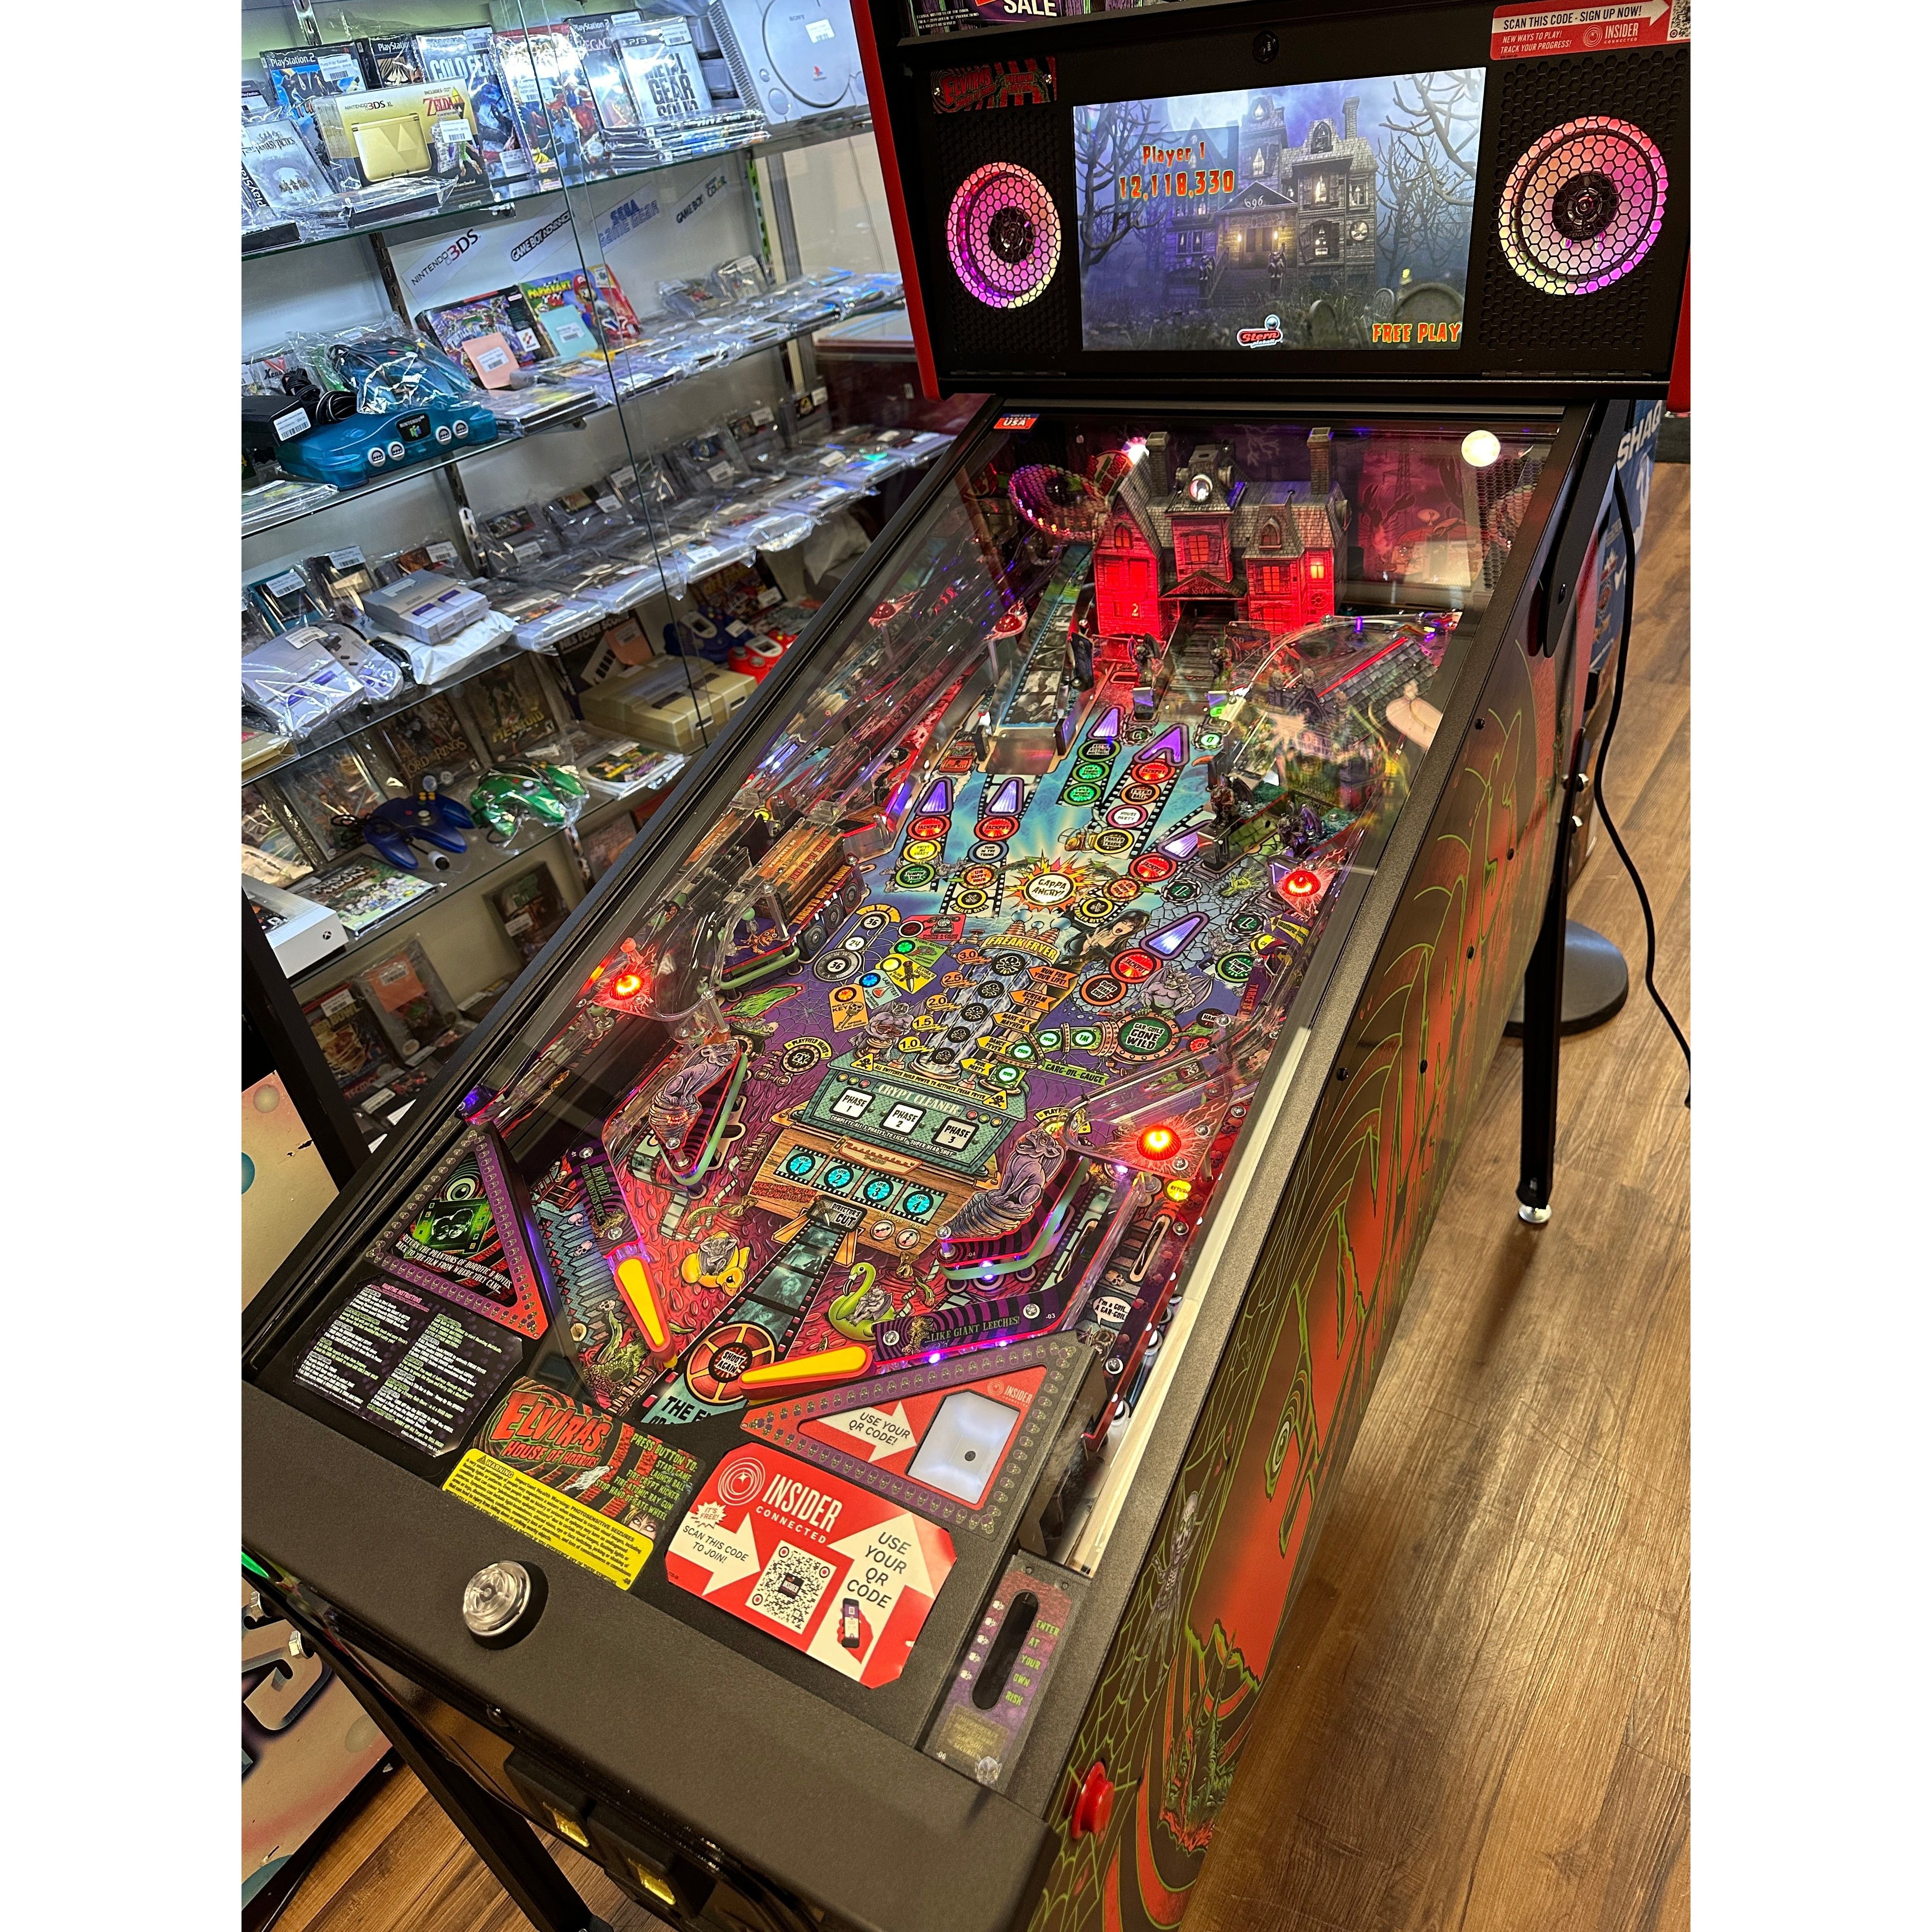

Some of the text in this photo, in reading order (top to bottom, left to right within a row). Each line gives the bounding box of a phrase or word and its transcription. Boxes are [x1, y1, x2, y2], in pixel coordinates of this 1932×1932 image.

[1004, 0, 1057, 17] SALE
[1504, 18, 1527, 30] SCAN
[1529, 16, 1548, 26] THIS
[1551, 13, 1573, 25] CODE
[1580, 11, 1601, 22] SIGN
[1603, 10, 1615, 19] UP
[1617, 6, 1642, 17] NOW!
[1503, 30, 1563, 44] NEW WAYS TO PLAY!
[1605, 23, 1639, 39] INSIDER
[1500, 40, 1572, 54] TRACK YOUR PROGRESS!
[1006, 72, 1033, 83] PREMIUM
[648, 74, 695, 105] GEAR
[1008, 82, 1031, 94] EDITION
[423, 97, 455, 116] ZELDA
[1142, 141, 1206, 167] Player 1
[1118, 169, 1234, 202] 12,118,330
[1243, 196, 1264, 209] 696
[610, 199, 640, 226] SEGA
[411, 228, 479, 286] NINTENDO 3DS
[1241, 330, 1281, 344] Stern
[1372, 322, 1460, 343] FREE PLAY
[1002, 419, 1027, 428] USA
[1032, 886, 1065, 897] ANGRY!
[1038, 879, 1067, 889] GAPPA
[987, 936, 1057, 960] FREAK FRYER
[1034, 972, 1051, 981] YOUR
[928, 997, 946, 1005] 2.0
[1022, 992, 1047, 1002] SCREAM
[1024, 998, 1040, 1006] TEST
[1000, 1019, 1025, 1029] MAYHEM
[1002, 1012, 1031, 1024] MAKE-OUT
[900, 1038, 918, 1048] 1.0
[988, 1037, 1006, 1046] DANCE
[1127, 1036, 1156, 1050] WILD
[1129, 1029, 1161, 1043] GONE
[984, 1043, 1002, 1051] FEVER
[968, 1064, 986, 1072] PARTY
[974, 1059, 987, 1067] POOL
[1045, 1063, 1106, 1083] GARG-OIL-GAUGE
[843, 1095, 868, 1107] PHASE
[878, 1084, 959, 1115] CRYPT CLEANER
[892, 1110, 918, 1122] PHASE
[944, 1125, 971, 1138] PHASE
[835, 1175, 843, 1184] 2
[872, 1187, 881, 1197] 3
[831, 1202, 862, 1217] DIRECTOR'S
[912, 1202, 921, 1211] 4
[836, 1213, 857, 1227] CUT
[403, 1234, 420, 1249] RETURN
[420, 1245, 431, 1255] THE
[430, 1249, 458, 1264] PHANTOMS
[466, 1260, 490, 1275] HORRIFIC
[930, 1315, 1021, 1342] LIKE GIANT LEECHES!
[721, 1350, 746, 1363] SHOOT
[717, 1360, 739, 1374] AGAIN
[1003, 1382, 1033, 1404] INSIDER
[666, 1395, 695, 1418] THE
[859, 1411, 911, 1439] USE YOUR
[848, 1419, 899, 1447] QR CODE!
[501, 1441, 600, 1469] HOUSE OF HORRORS
[632, 1433, 697, 1472] PRESS BUTTON TO:
[656, 1460, 692, 1481] START GAME
[626, 1470, 680, 1501] FIRE CRYPT KICKER
[650, 1469, 686, 1491] LAUNCH BALL
[486, 1460, 634, 1542] WARNING Important Health Warning: PHOTOSENSITIVE SEIZURES
[614, 1476, 674, 1512] FIRE ATOMIC RAY GUN
[761, 1473, 843, 1533] INSIDER
[700, 1511, 719, 1521] FREE!
[755, 1505, 828, 1545] CONNECTED
[683, 1525, 749, 1562] SCAN THIS CODE
[877, 1531, 912, 1555] USE
[692, 1541, 728, 1564] TO JOIN!
[865, 1545, 907, 1575] YOUR
[865, 1567, 889, 1587] QR
[846, 1578, 892, 1608] CODE
[1035, 1619, 1061, 1635] ENTER
[1027, 1638, 1040, 1648] AT
[1021, 1654, 1041, 1670] YOUR
[1012, 1673, 1031, 1687] OWN
[1005, 1691, 1024, 1706] RISK
[935, 1751, 947, 1760] -06
